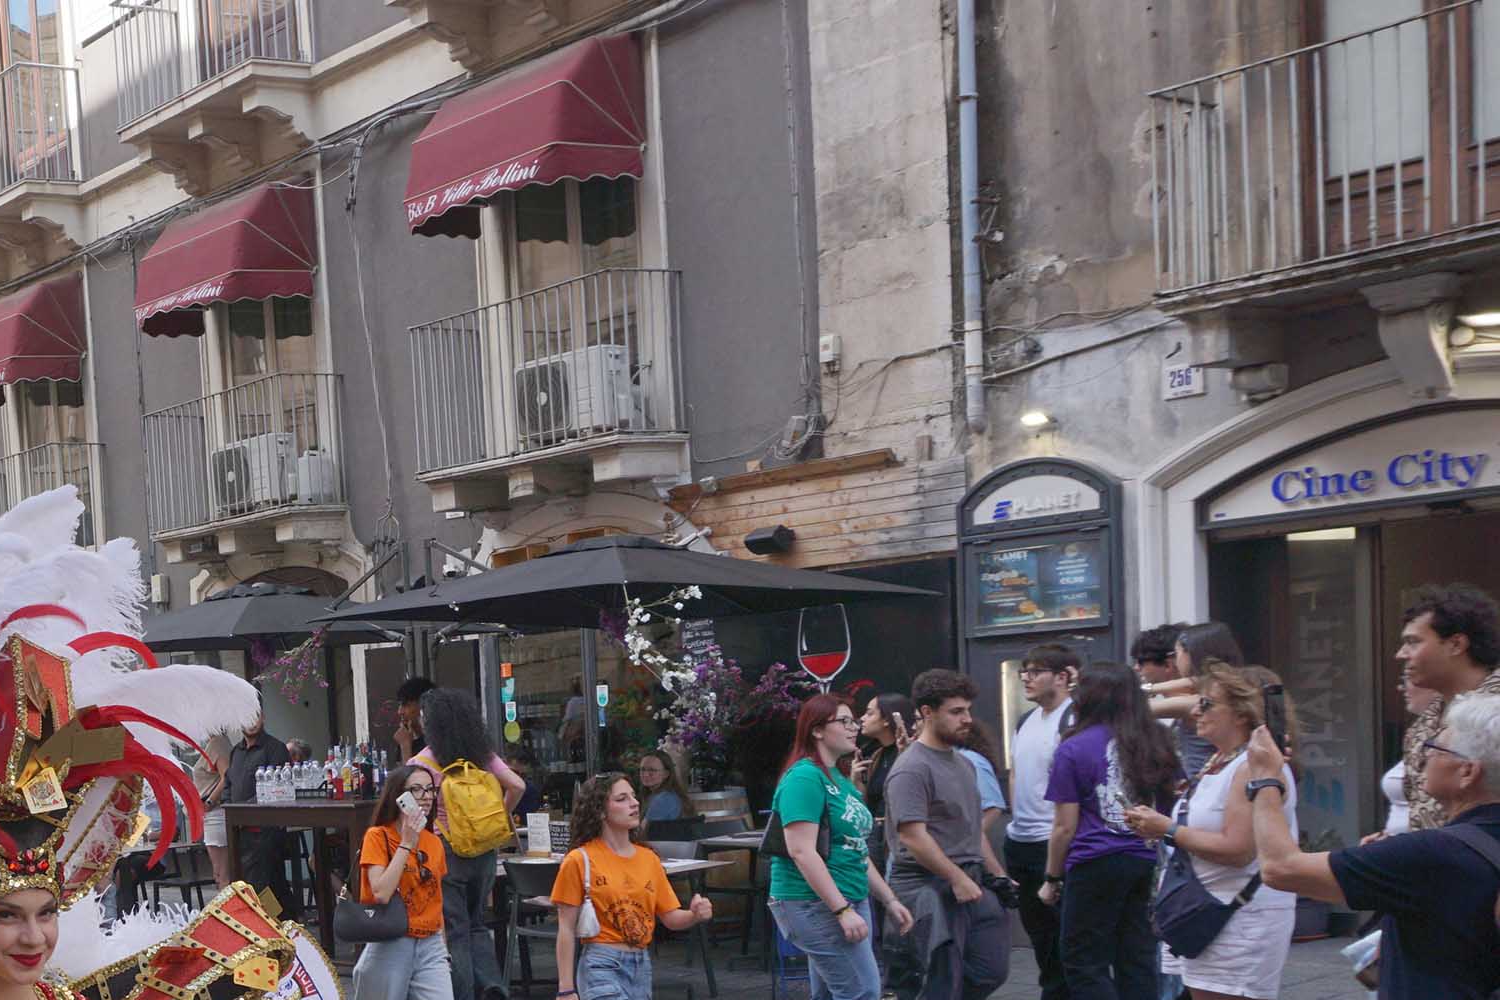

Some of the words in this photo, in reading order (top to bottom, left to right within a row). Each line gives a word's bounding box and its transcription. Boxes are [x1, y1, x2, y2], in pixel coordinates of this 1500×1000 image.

[407, 194, 437, 223] B&B
[440, 178, 473, 207] Villa
[475, 159, 541, 192] Bellini
[177, 280, 224, 304] Bellini
[1169, 367, 1192, 389] 256
[1271, 466, 1374, 503] Cine
[1387, 450, 1486, 487] City
[1012, 490, 1079, 515] PLANET
